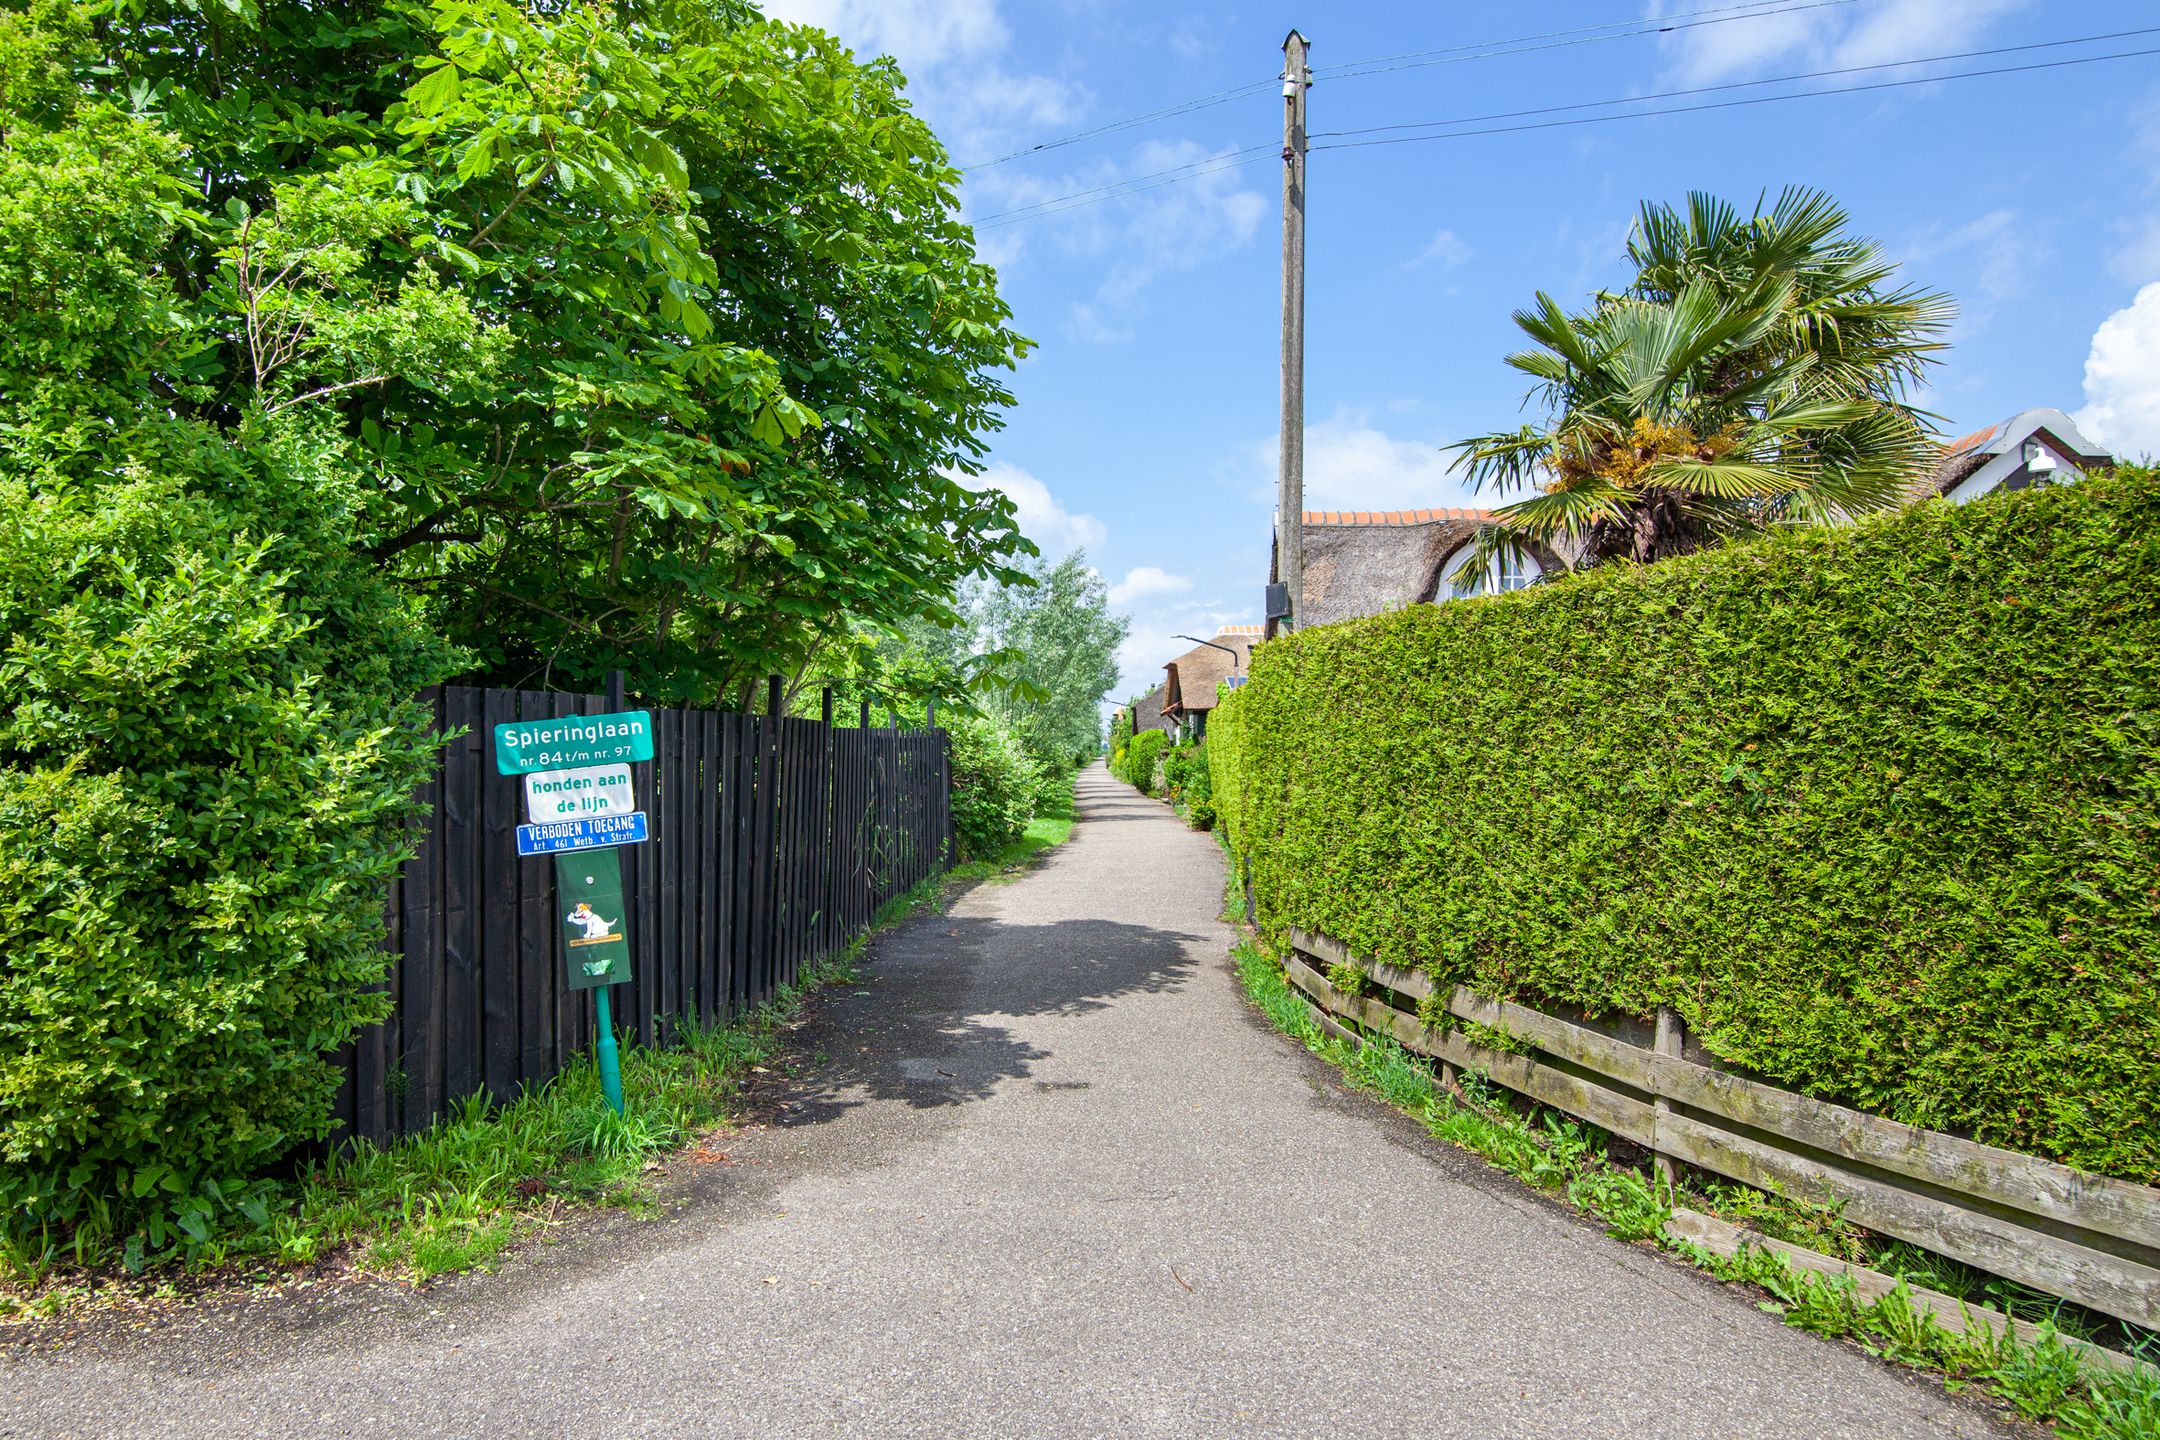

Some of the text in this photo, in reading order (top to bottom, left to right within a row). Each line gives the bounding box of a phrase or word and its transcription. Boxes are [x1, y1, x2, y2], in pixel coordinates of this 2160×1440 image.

[504, 721, 643, 749] Spieringlaan
[520, 745, 632, 766] nr. 84 t/m nr. 97
[532, 774, 627, 794] honden aan
[557, 796, 608, 813] de lijn
[528, 816, 635, 840] VERBODEN TOEGANG
[533, 841, 549, 851] Art.
[554, 839, 568, 848] 461
[573, 837, 596, 846] Wetb.
